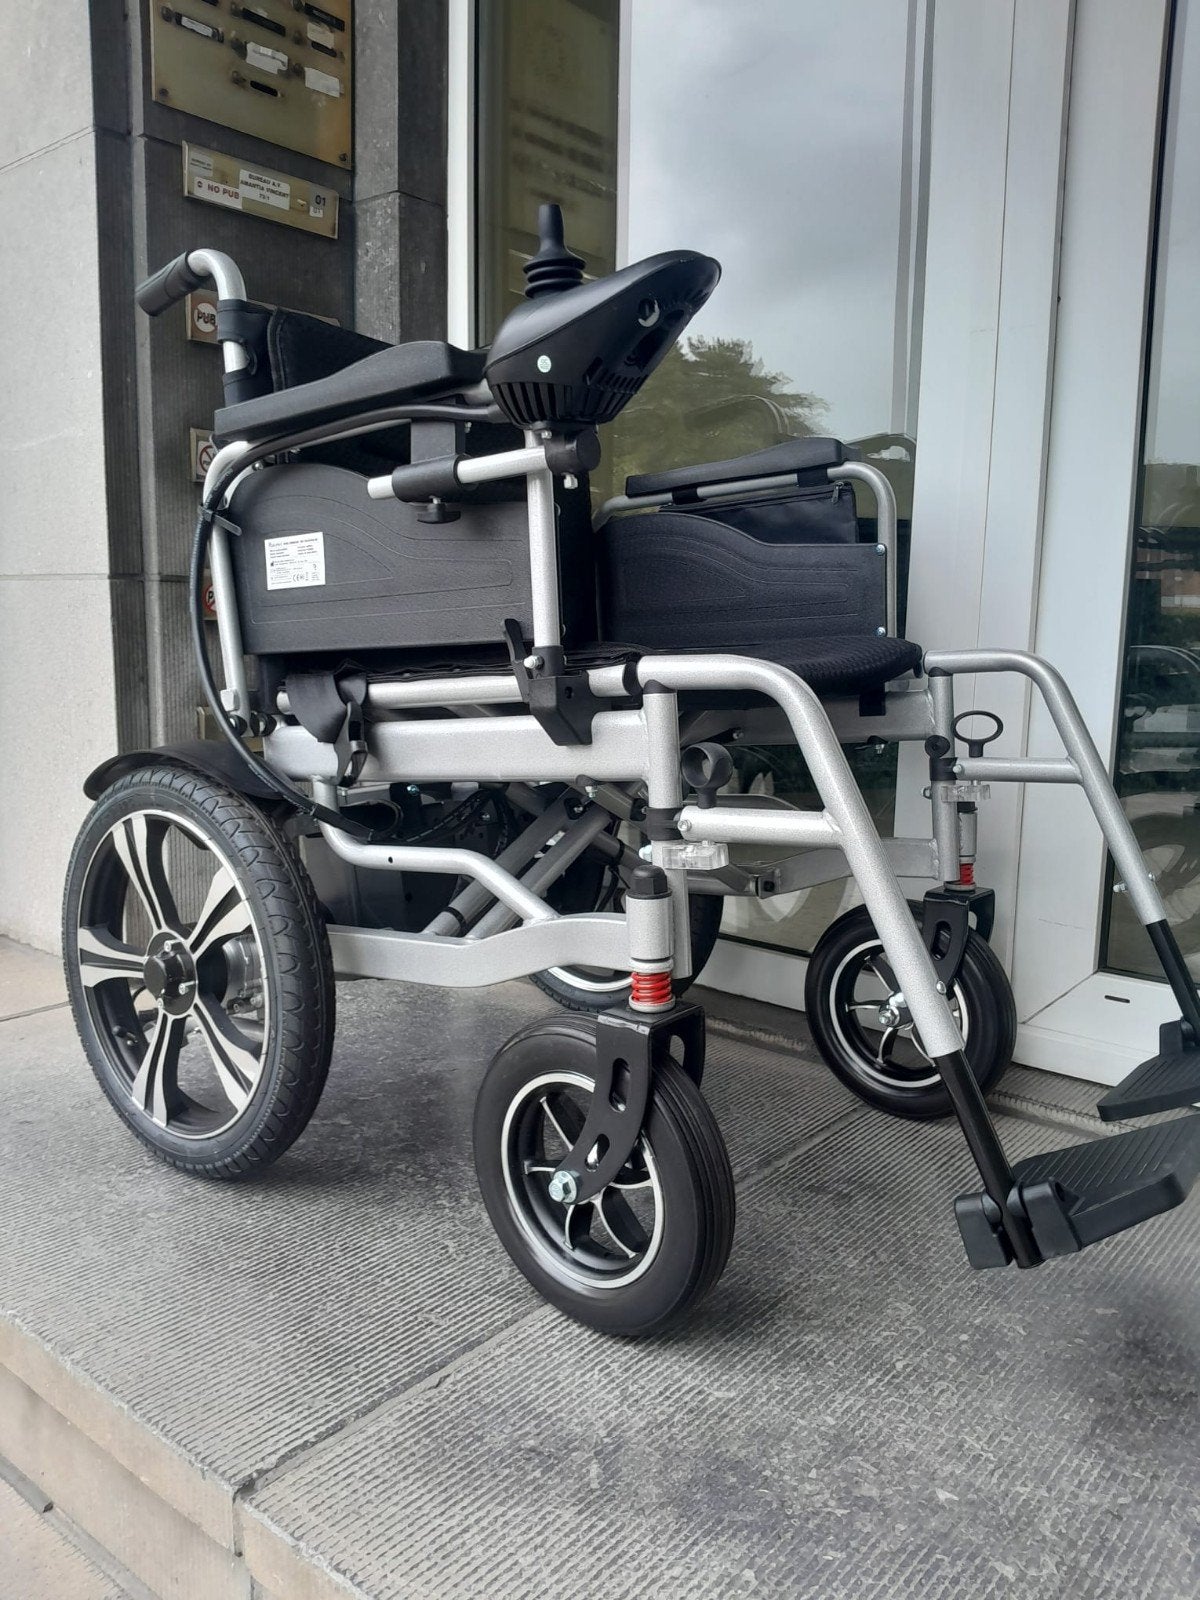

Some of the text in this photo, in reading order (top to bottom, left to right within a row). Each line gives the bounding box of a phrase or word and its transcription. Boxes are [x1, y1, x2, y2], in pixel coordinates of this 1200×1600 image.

[207, 183, 240, 200] NO PUB
[315, 194, 326, 206] 01
[197, 310, 216, 325] PUB
